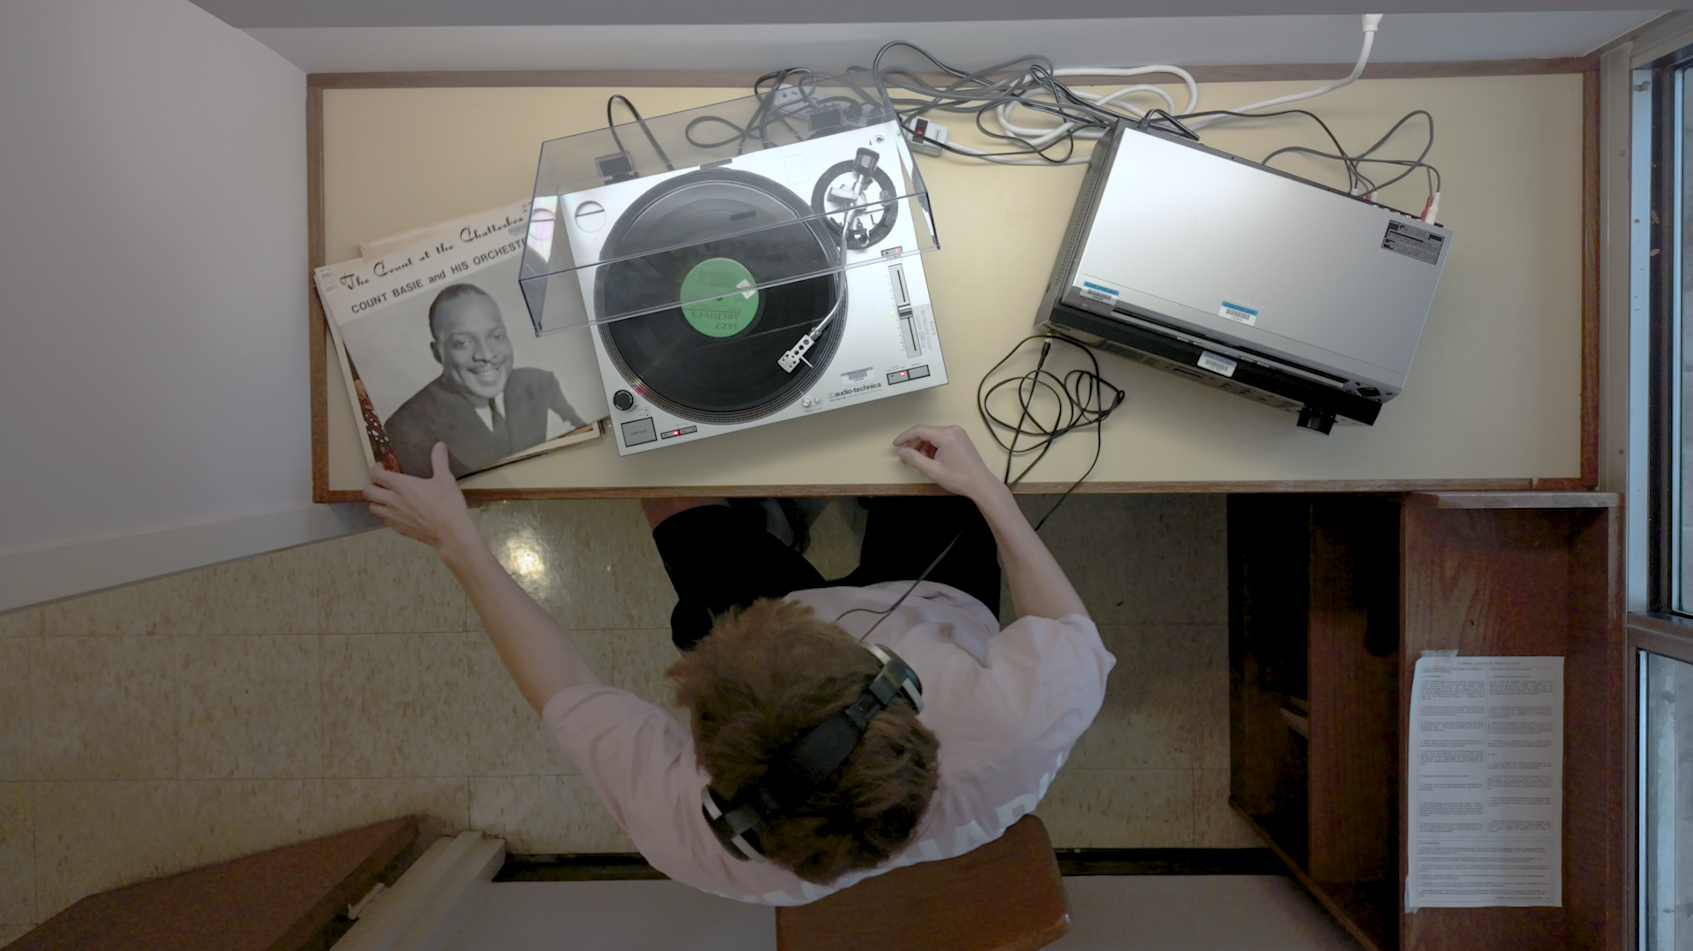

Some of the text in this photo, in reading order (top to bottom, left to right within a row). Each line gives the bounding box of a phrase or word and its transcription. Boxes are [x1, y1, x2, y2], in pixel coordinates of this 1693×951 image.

[339, 272, 370, 290] The
[373, 259, 413, 277] Count
[419, 250, 431, 262] at
[436, 242, 455, 254] the
[459, 215, 524, 243] Chatterbox
[351, 292, 388, 314] COUNT
[392, 278, 424, 298] BASIE
[428, 270, 447, 284] and
[450, 261, 469, 275] HIS
[714, 322, 739, 330] JAZZ
[834, 382, 882, 397] audio-technica
